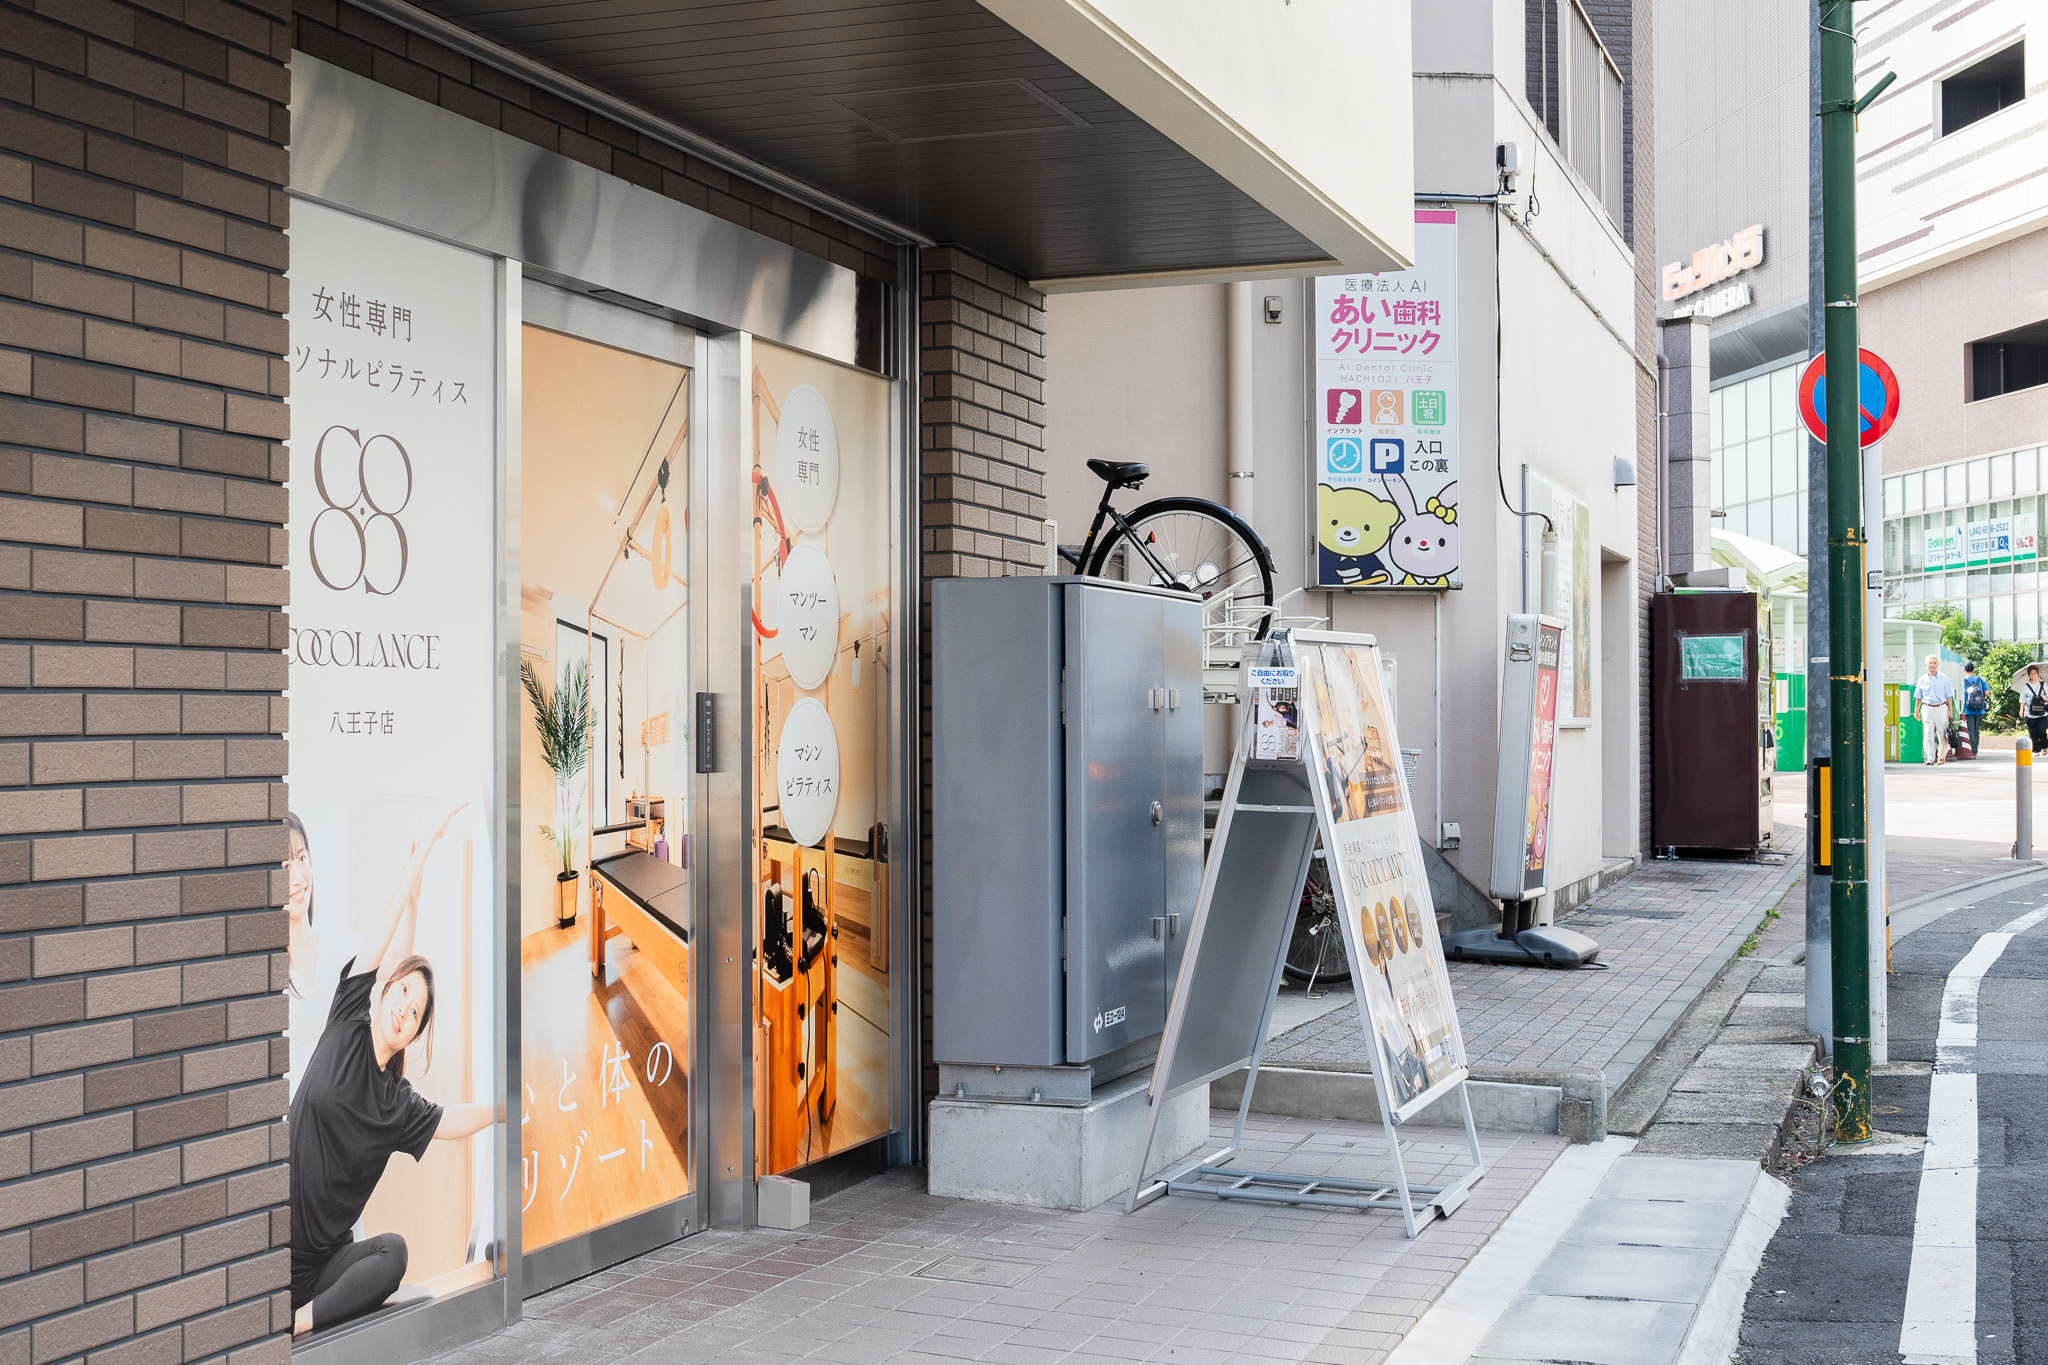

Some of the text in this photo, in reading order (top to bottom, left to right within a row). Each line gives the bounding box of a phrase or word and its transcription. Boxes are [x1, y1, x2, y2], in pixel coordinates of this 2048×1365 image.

[312, 286, 412, 342] 女性専門
[1330, 293, 1441, 325] あい歯科
[1331, 328, 1440, 355] クリニック
[1400, 364, 1433, 372] Clinic
[1341, 375, 1432, 384] HACHIOJI 八王子
[1419, 398, 1437, 409] 土日
[1423, 409, 1434, 419] 祝
[797, 426, 819, 452] 女性
[1415, 440, 1442, 454] 入口
[1374, 443, 1400, 470] P
[1410, 459, 1448, 473] この裏
[797, 460, 820, 487] 専門
[789, 591, 827, 610] マンツー
[799, 624, 818, 641] マン
[1251, 669, 1295, 677] ご自由にお取り
[329, 710, 394, 735] 八王子店
[795, 745, 822, 762] マシン
[786, 777, 832, 797] ピラティス
[522, 1119, 654, 1213] リゾート
